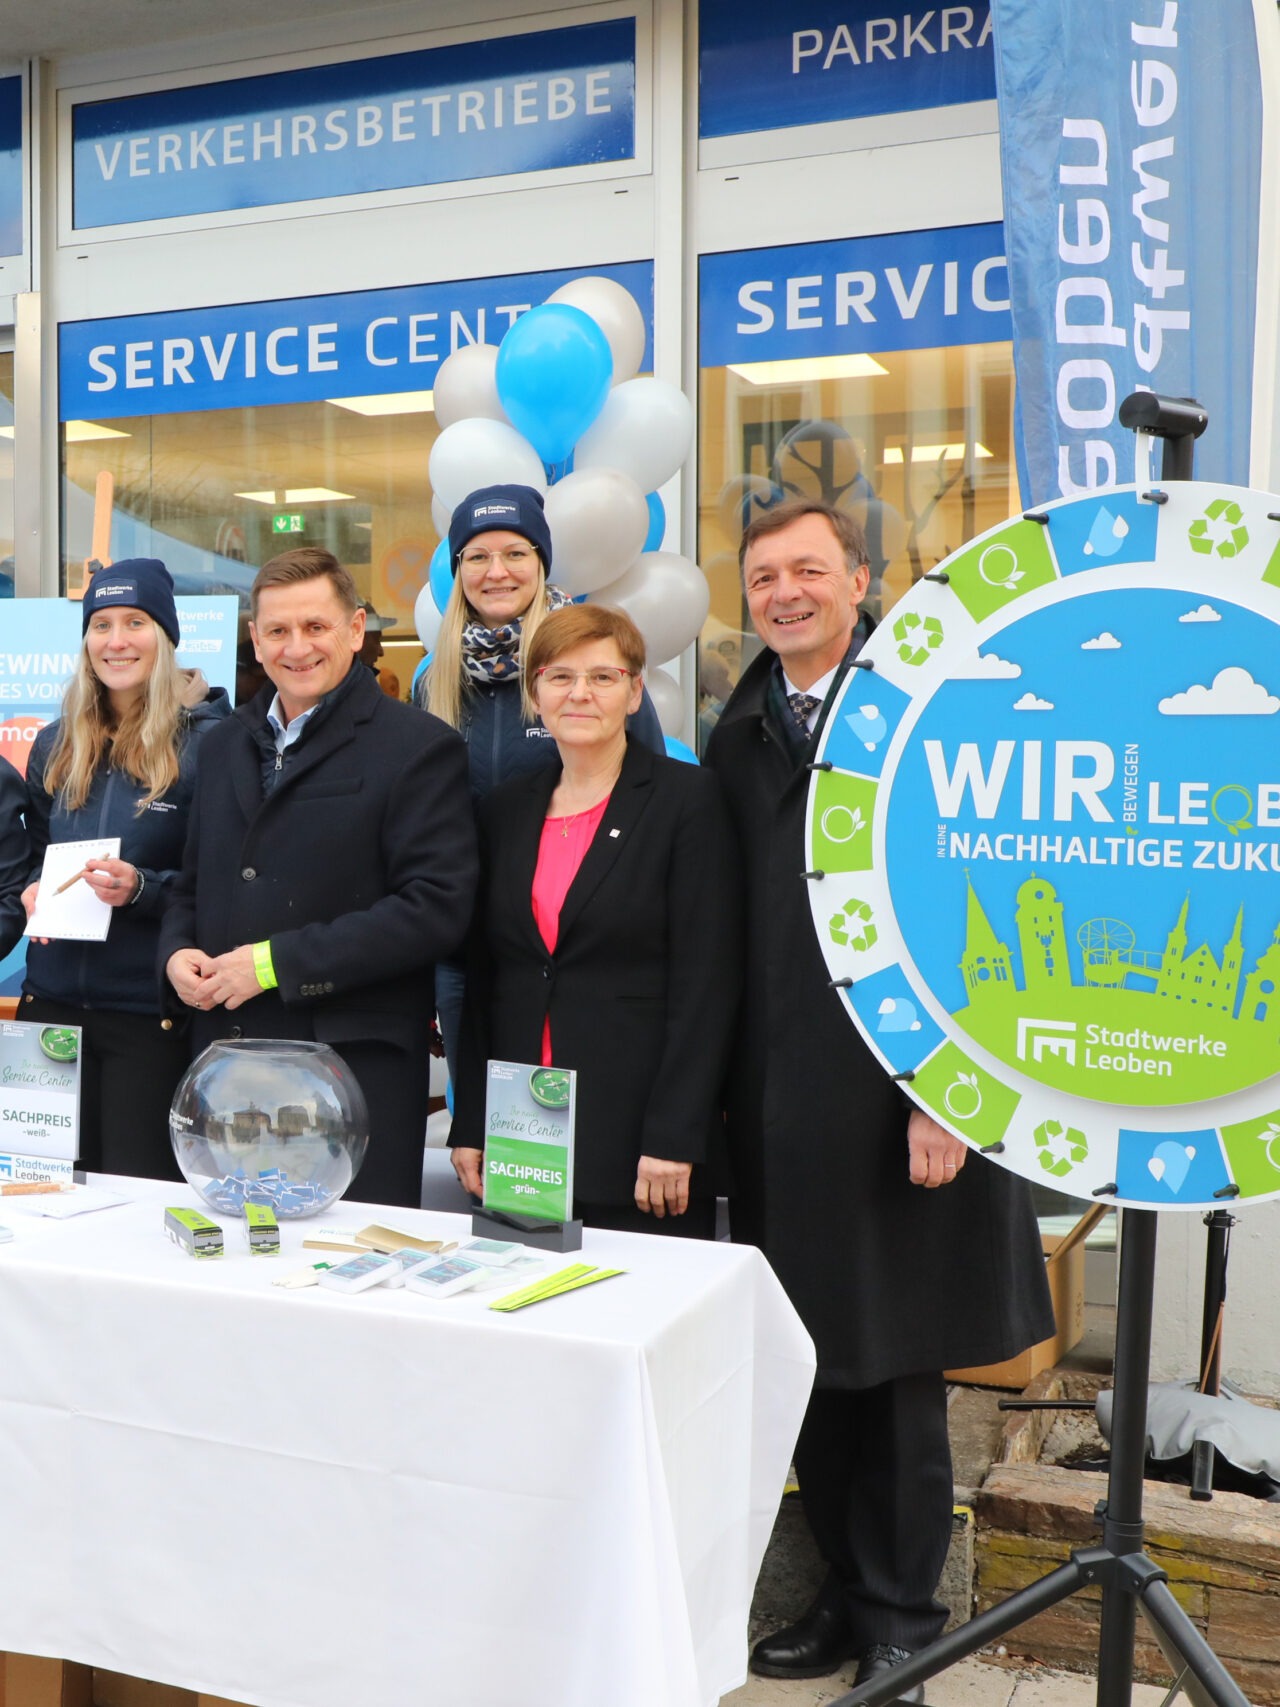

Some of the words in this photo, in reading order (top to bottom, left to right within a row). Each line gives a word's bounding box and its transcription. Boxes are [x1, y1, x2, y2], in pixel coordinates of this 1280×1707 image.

[94, 70, 612, 181] VERKEHRSBETRIEBE
[736, 256, 1011, 335] SERVIC
[88, 322, 338, 392] SERVICE
[365, 304, 531, 367] CENT
[924, 740, 1115, 823] WIR
[1123, 743, 1139, 822] BEWEGEN
[937, 824, 946, 845] EINE
[937, 846, 946, 858] IN
[950, 832, 1183, 868] NACHHALTIGE
[1085, 1024, 1227, 1057] Stadtwerke
[1085, 1048, 1172, 1076] Leoben
[2, 1065, 36, 1083] Service
[39, 1071, 73, 1087] Center
[3, 1109, 71, 1128] SACHPREIS
[490, 1112, 527, 1132] Service
[528, 1120, 563, 1138] Center
[15, 1158, 72, 1174] Stadtwerke
[15, 1169, 51, 1181] Leoben
[489, 1161, 563, 1185] SACHPREIS
